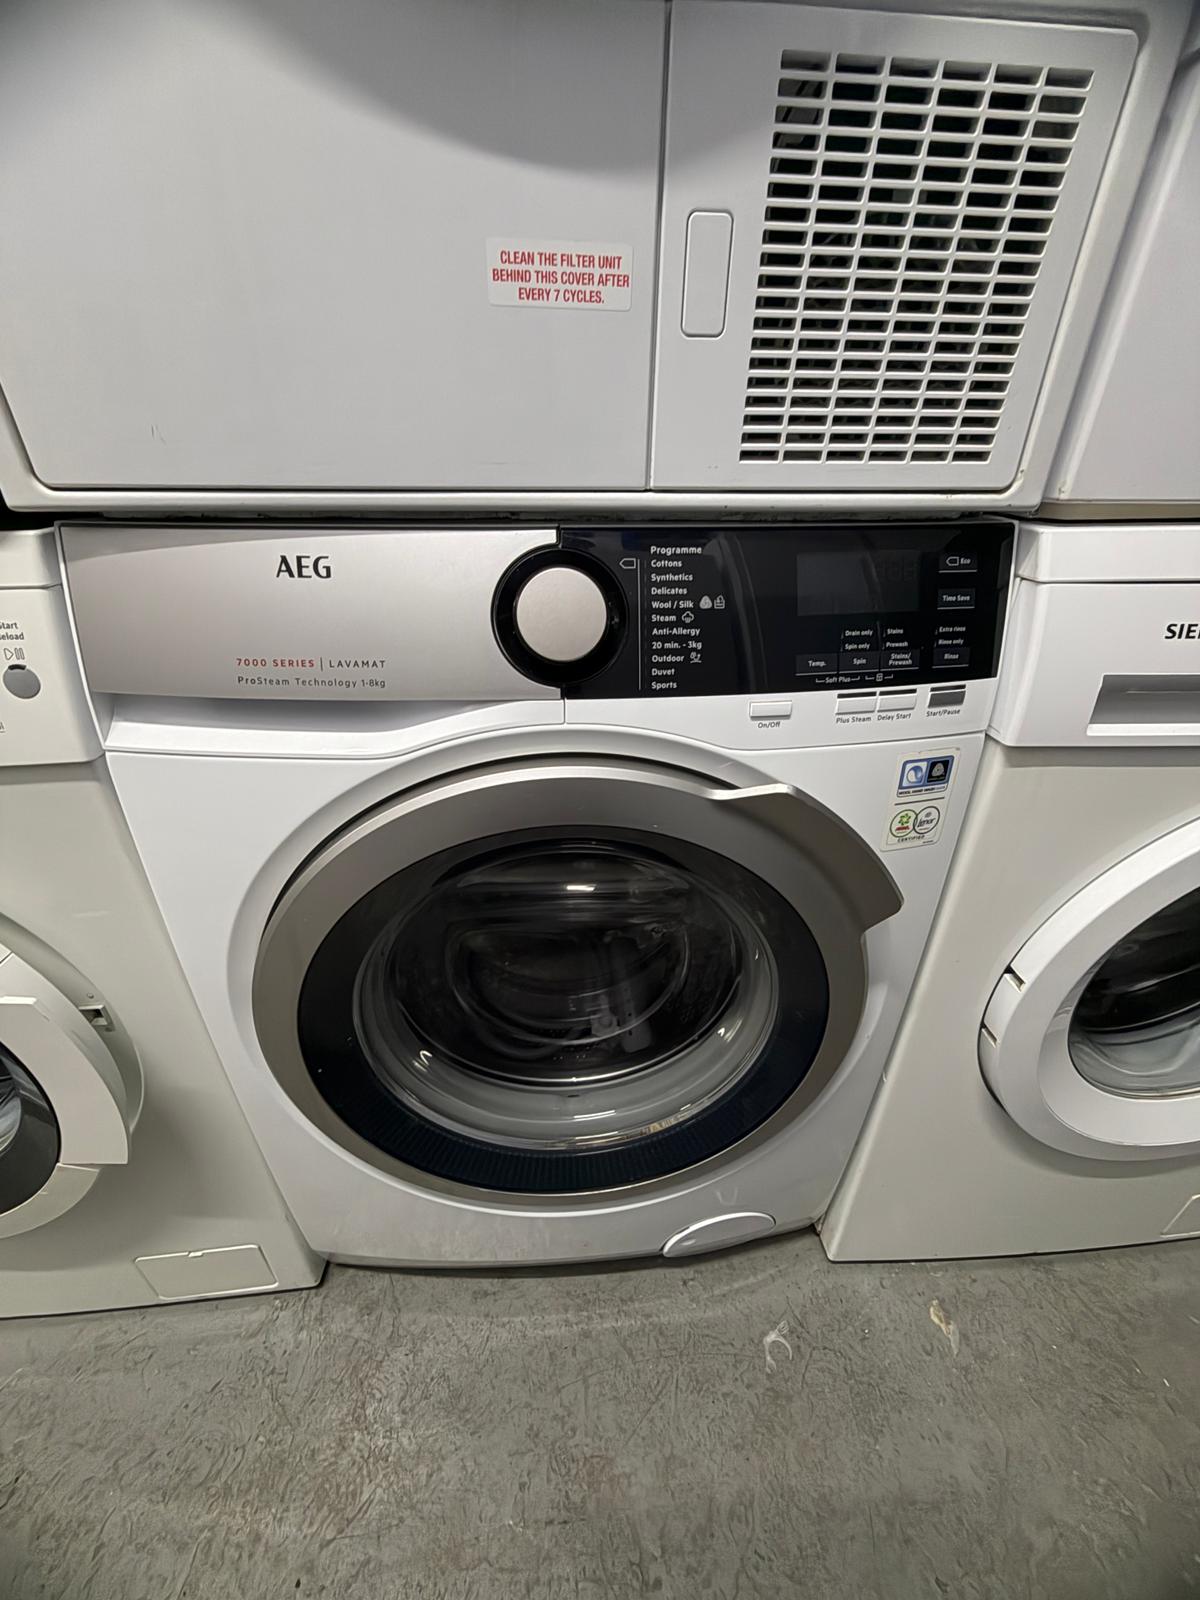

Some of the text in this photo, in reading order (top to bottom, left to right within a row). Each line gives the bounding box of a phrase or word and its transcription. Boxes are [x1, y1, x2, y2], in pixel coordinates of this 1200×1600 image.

[500, 250, 623, 270] CLEAN THE FILTER UNIT
[492, 268, 630, 288] BEHIND THIS COVER AFTER
[518, 287, 605, 304] EVERY 7 CYCLES.
[650, 545, 703, 556] Programme
[276, 554, 332, 579] AEG
[651, 559, 682, 568] Cottons
[651, 573, 694, 583] Synthetics
[651, 586, 688, 595] Delicates
[651, 600, 672, 609] Wool
[679, 600, 694, 608] Silk
[651, 614, 677, 622] Steam
[652, 627, 701, 637] Anti-Allergy
[845, 629, 861, 637] Drain
[652, 641, 662, 650] 20
[664, 641, 681, 649] min.
[687, 640, 702, 650] 3kg
[845, 642, 858, 650] Spin
[236, 657, 386, 669] 7000 SERIES LAVAMAT
[652, 654, 685, 663] Outdoor
[808, 659, 827, 668] Temp.
[853, 657, 867, 665] Spin
[889, 659, 913, 667] Prewash
[651, 668, 675, 677] Duvet
[237, 675, 290, 686] ProSteam
[294, 677, 358, 690] Technology
[825, 675, 838, 684] Soft
[651, 681, 678, 691] Sports
[895, 712, 912, 720] Start
[926, 708, 961, 718] Start/Pause
[757, 720, 781, 730] On/Off
[835, 715, 872, 725] Plus Steam
